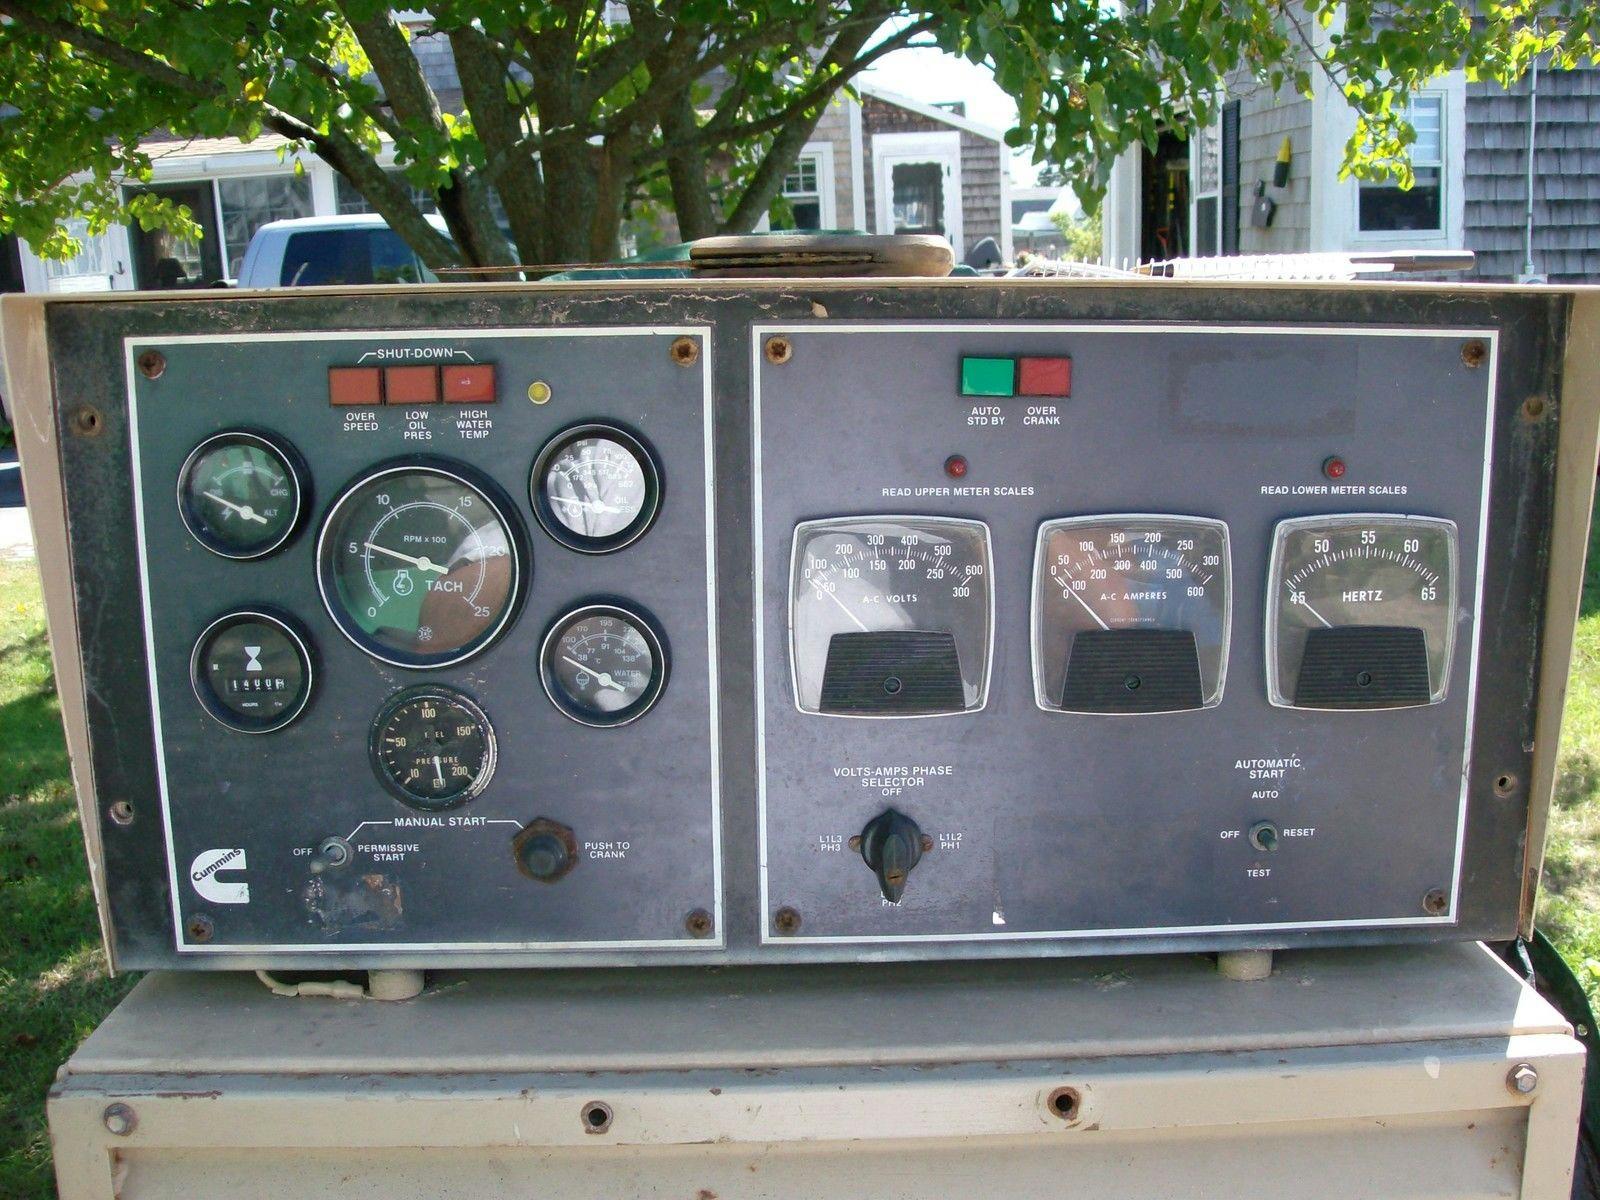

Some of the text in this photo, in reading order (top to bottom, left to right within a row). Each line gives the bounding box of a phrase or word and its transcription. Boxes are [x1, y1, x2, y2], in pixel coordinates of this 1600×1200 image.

[377, 348, 453, 359] SHUT-DOWN
[405, 411, 429, 419] LOW
[460, 410, 488, 419] HIGH
[971, 406, 1001, 415] AUTO
[1027, 406, 1057, 415] OVER
[346, 412, 375, 421] OVER
[967, 416, 1006, 425] STD BY
[1023, 416, 1060, 425] CRANK
[343, 422, 379, 431] SPEED
[409, 421, 427, 430] OIL
[456, 420, 493, 429] WATER
[404, 431, 432, 440] PRES
[460, 430, 489, 439] TEMP
[882, 487, 1035, 497] READ UPPER METER SCALES
[1260, 486, 1408, 495] READ LOWER METER SCALES
[376, 494, 390, 505] 10
[459, 496, 473, 507] 15
[404, 535, 422, 543] RPM
[432, 536, 447, 544] 100
[867, 535, 884, 545] 300
[901, 535, 918, 545] 400
[1110, 533, 1125, 543] 150
[1144, 533, 1161, 543] 200
[1361, 530, 1376, 544] 55
[349, 542, 358, 553] 5
[835, 544, 852, 554] 200
[1079, 541, 1094, 551] 100
[1177, 540, 1193, 550] 250
[1314, 539, 1329, 553] 50
[1404, 539, 1419, 553] 60
[934, 545, 952, 556] 500
[811, 559, 827, 570] 100
[898, 560, 915, 570] 200
[1058, 555, 1069, 565] 50
[1139, 560, 1158, 570] 400
[1203, 556, 1219, 565] 300
[869, 560, 886, 571] 150
[965, 565, 983, 575] 600
[1051, 565, 1057, 576] 0
[1114, 560, 1131, 571] 300
[804, 569, 811, 579] 0
[843, 568, 860, 578] 100
[926, 569, 944, 579] 250
[1090, 569, 1107, 579] 200
[1166, 569, 1183, 579] 500
[425, 580, 463, 592] TACH
[1071, 580, 1086, 591] 100
[816, 590, 822, 600] 0
[952, 587, 970, 597] 300
[1063, 589, 1069, 600] 0
[1100, 592, 1167, 601] A-C AMPERES
[1187, 586, 1204, 597] 600
[1342, 590, 1383, 602] HERTZ
[1421, 587, 1436, 601] 65
[862, 594, 918, 604] A-C VOLTS
[1290, 591, 1306, 605] 45
[367, 606, 377, 618] 0
[474, 606, 490, 617] 25
[421, 708, 436, 718] 100
[457, 726, 471, 736] 150
[395, 738, 407, 747] 50
[1234, 758, 1301, 769] AUTOMATIC
[410, 768, 419, 778] 10
[452, 766, 468, 776] 200
[833, 766, 953, 777] VOLTS-AMPS PHASE
[1249, 769, 1285, 779] START
[861, 777, 925, 787] SELECTOR
[881, 788, 902, 796] OFF
[1251, 790, 1279, 799] AUTO
[394, 817, 487, 827] MANUAL START
[939, 833, 962, 841] L1L2
[1220, 830, 1240, 839] OFF
[1283, 828, 1315, 837] RESET
[819, 835, 842, 843] L1L3
[358, 844, 420, 852] PERMISSIVE
[585, 841, 630, 850] PUSH TO
[821, 843, 841, 851] PH3
[941, 842, 961, 850] PH1
[293, 848, 313, 856] OFF
[590, 850, 626, 859] CRANK
[373, 853, 405, 862] START
[192, 847, 241, 882] Cummins
[1246, 869, 1271, 877] TEST
